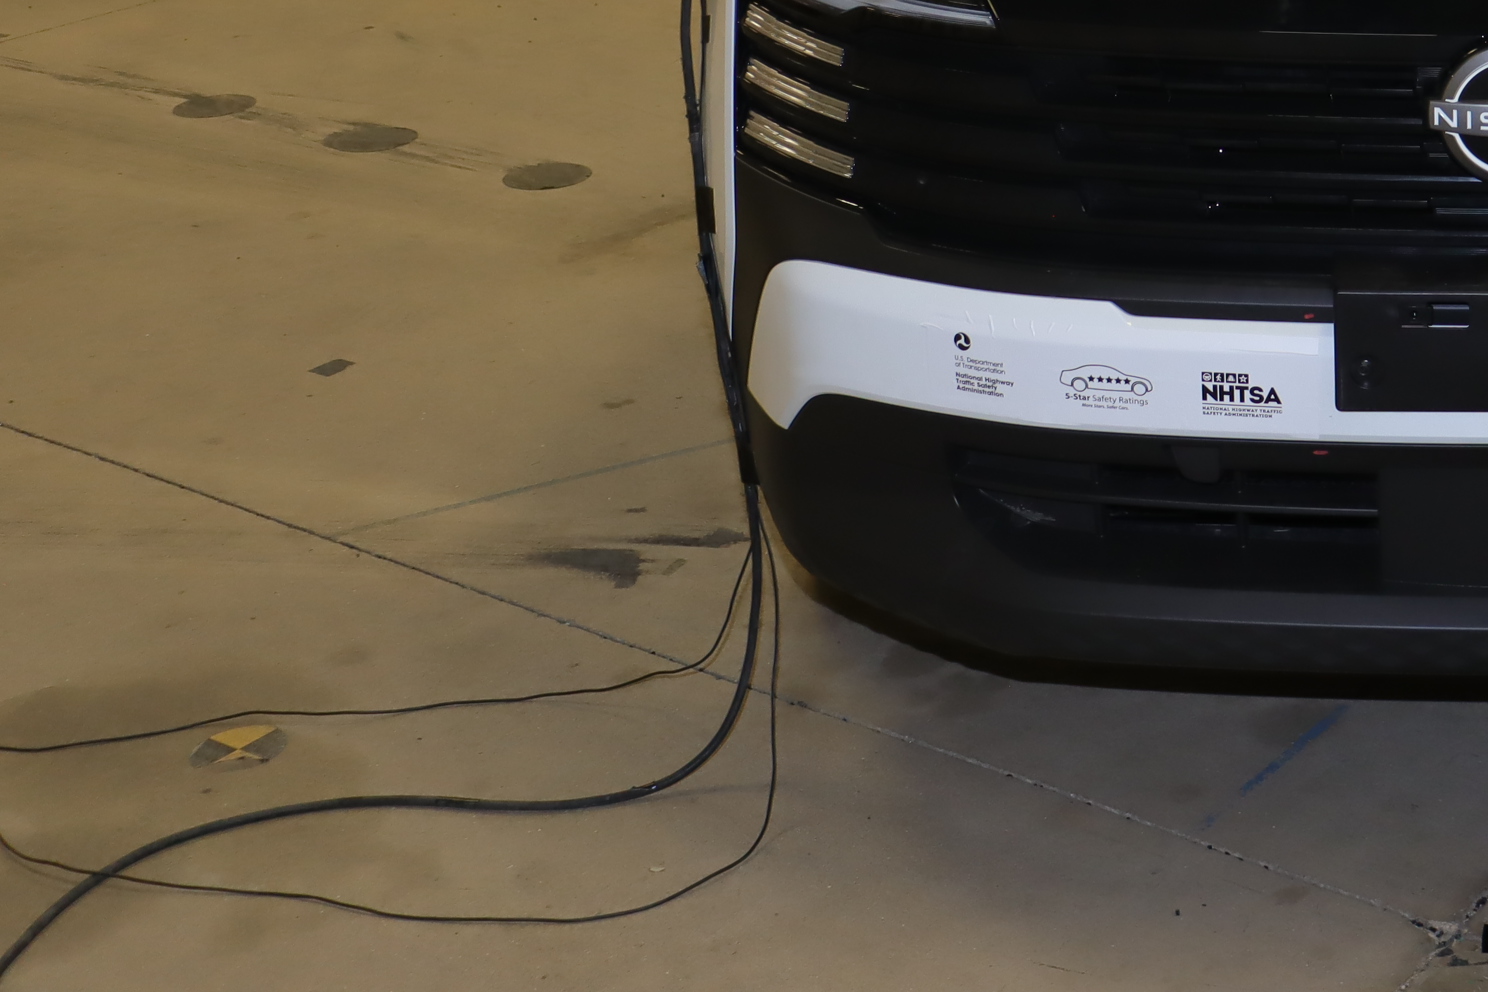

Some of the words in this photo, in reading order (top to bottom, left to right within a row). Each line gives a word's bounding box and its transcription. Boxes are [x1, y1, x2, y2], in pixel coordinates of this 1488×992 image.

[962, 362, 1006, 375] Transportation
[966, 356, 1004, 368] Department
[955, 371, 983, 382] National
[984, 376, 1014, 388] Highway
[956, 378, 975, 387] Traffic
[976, 381, 997, 391] Safety
[956, 385, 1005, 398] Administration
[1202, 384, 1282, 404] NHTSA
[1065, 392, 1090, 402] 5-Star
[1092, 394, 1118, 405] Safety
[1118, 396, 1149, 407] Ratings
[1224, 411, 1273, 419] ADMINISTRATION
